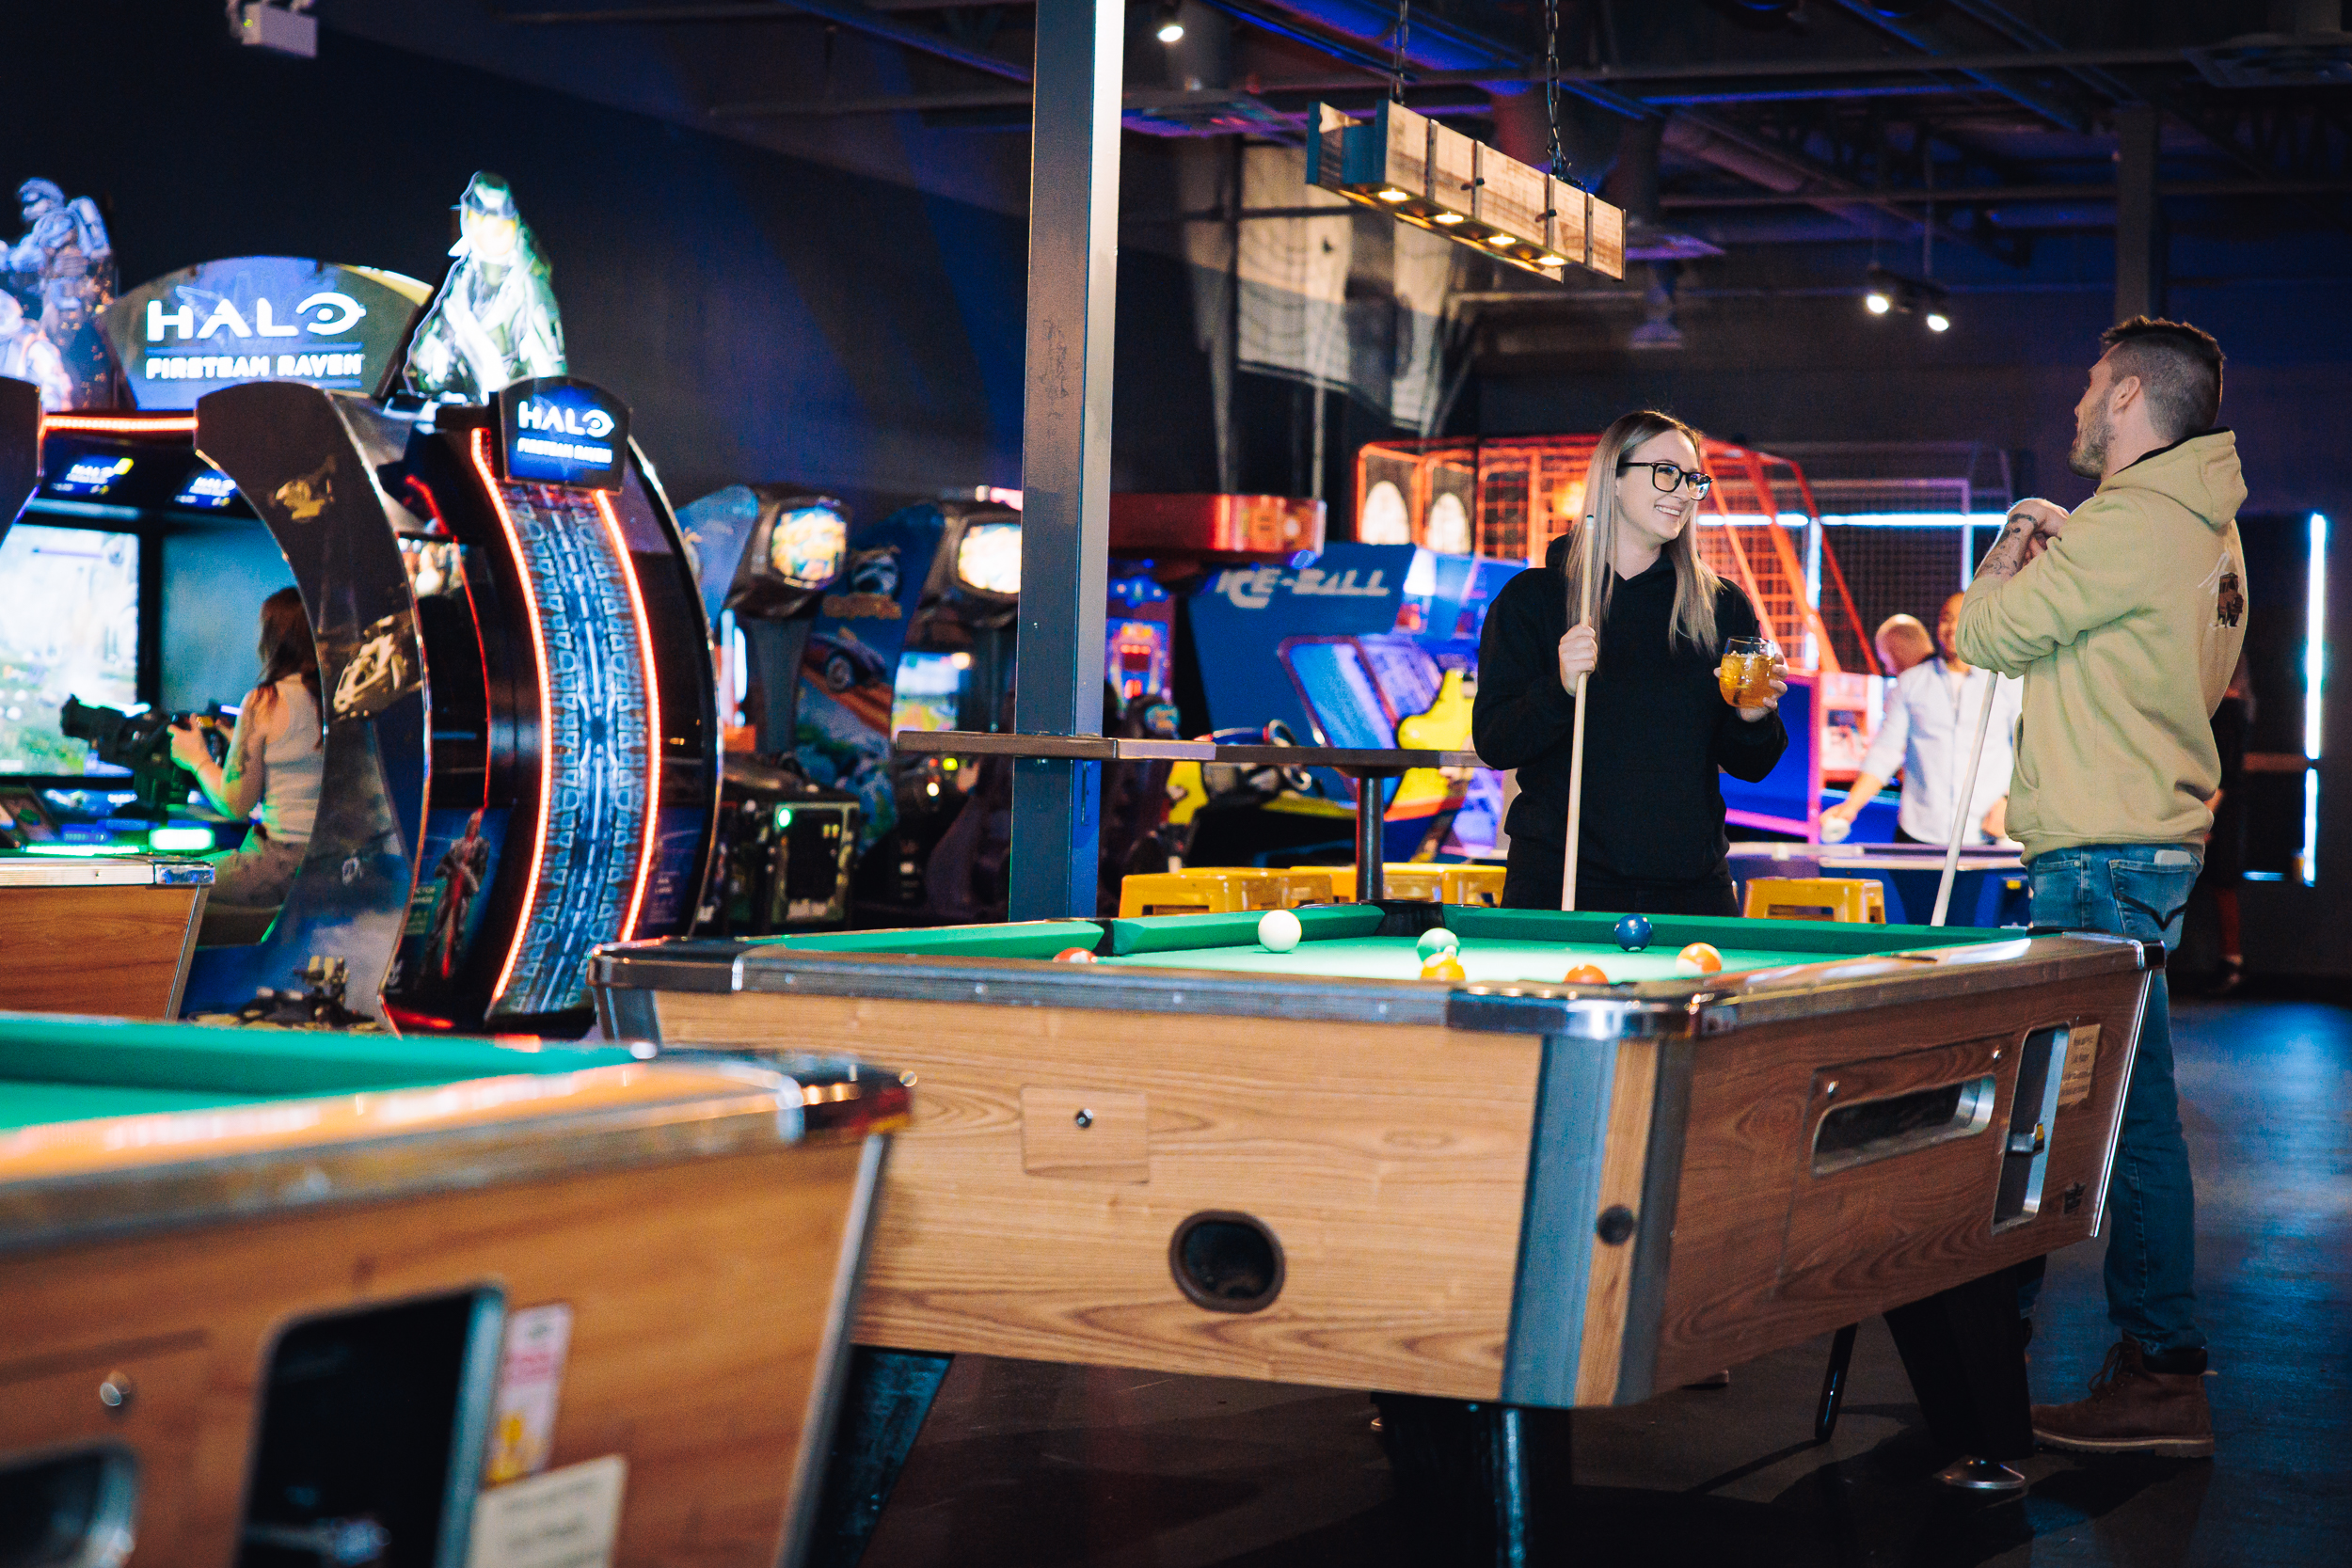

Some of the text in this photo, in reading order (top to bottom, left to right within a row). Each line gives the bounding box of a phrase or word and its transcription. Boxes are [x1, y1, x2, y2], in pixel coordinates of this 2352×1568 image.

[147, 292, 367, 341] HALO
[145, 353, 363, 379] FIRETEAM RAVEN
[517, 401, 615, 437] HALO
[1215, 567, 1391, 610] ICE-BALL
